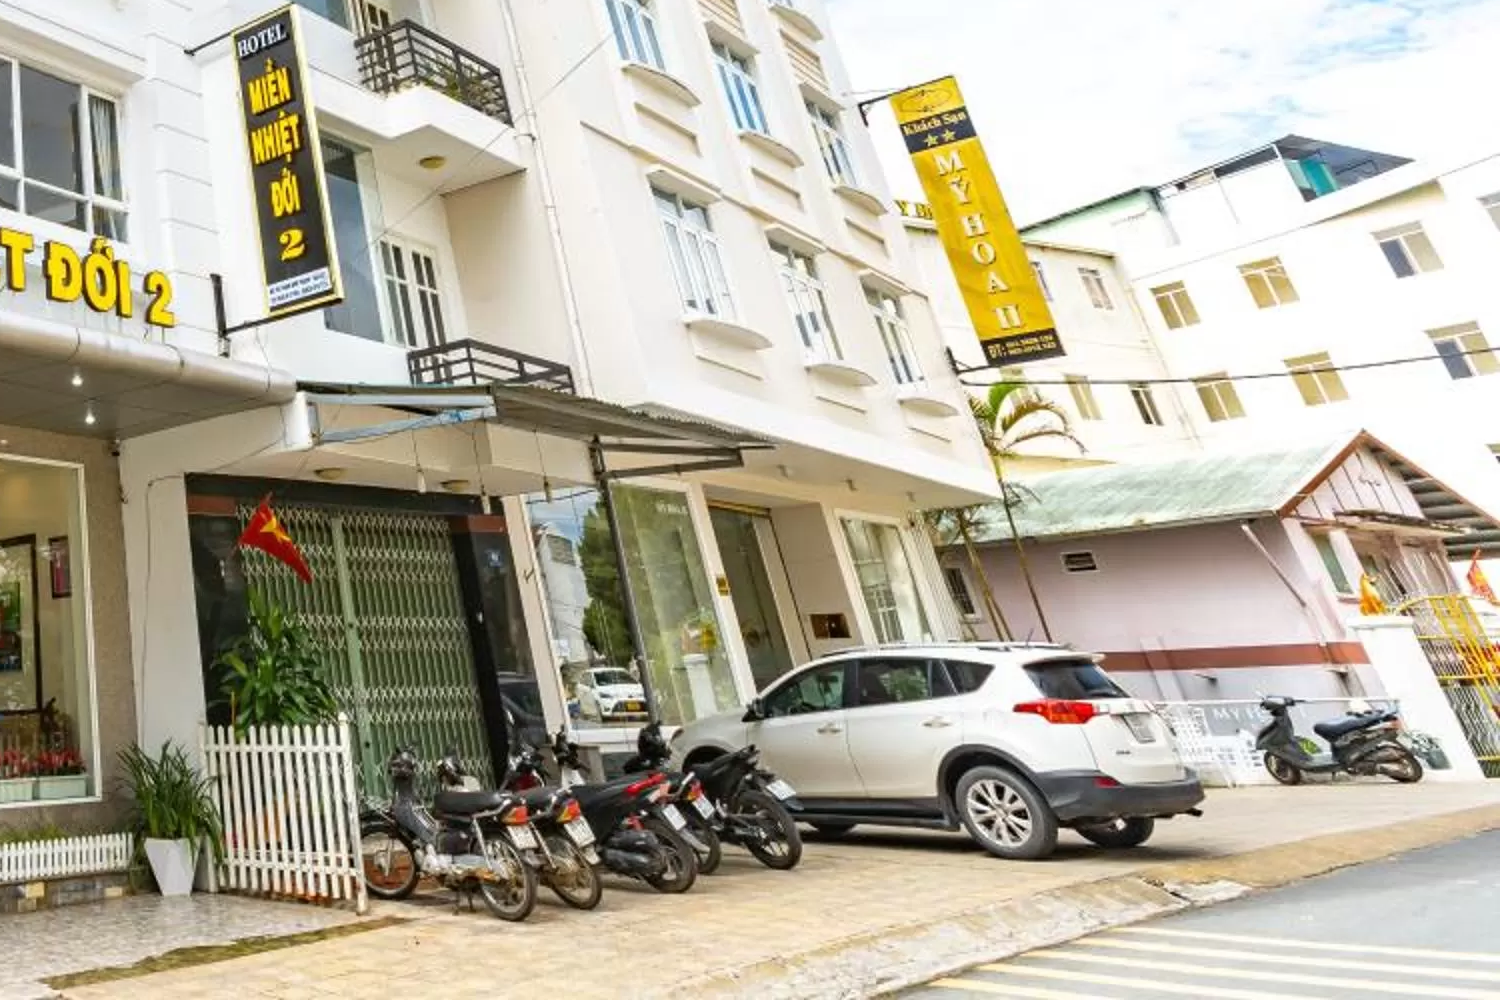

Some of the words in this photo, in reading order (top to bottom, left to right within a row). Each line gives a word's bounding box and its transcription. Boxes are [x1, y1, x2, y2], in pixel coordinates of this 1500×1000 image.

[238, 23, 287, 57] HOTEL
[248, 57, 291, 114] MIỀN
[251, 110, 300, 164] NHIỆT
[270, 167, 301, 217] ĐỚI
[279, 228, 306, 261] 2
[43, 236, 132, 317] ĐỚI
[144, 269, 175, 328] 2
